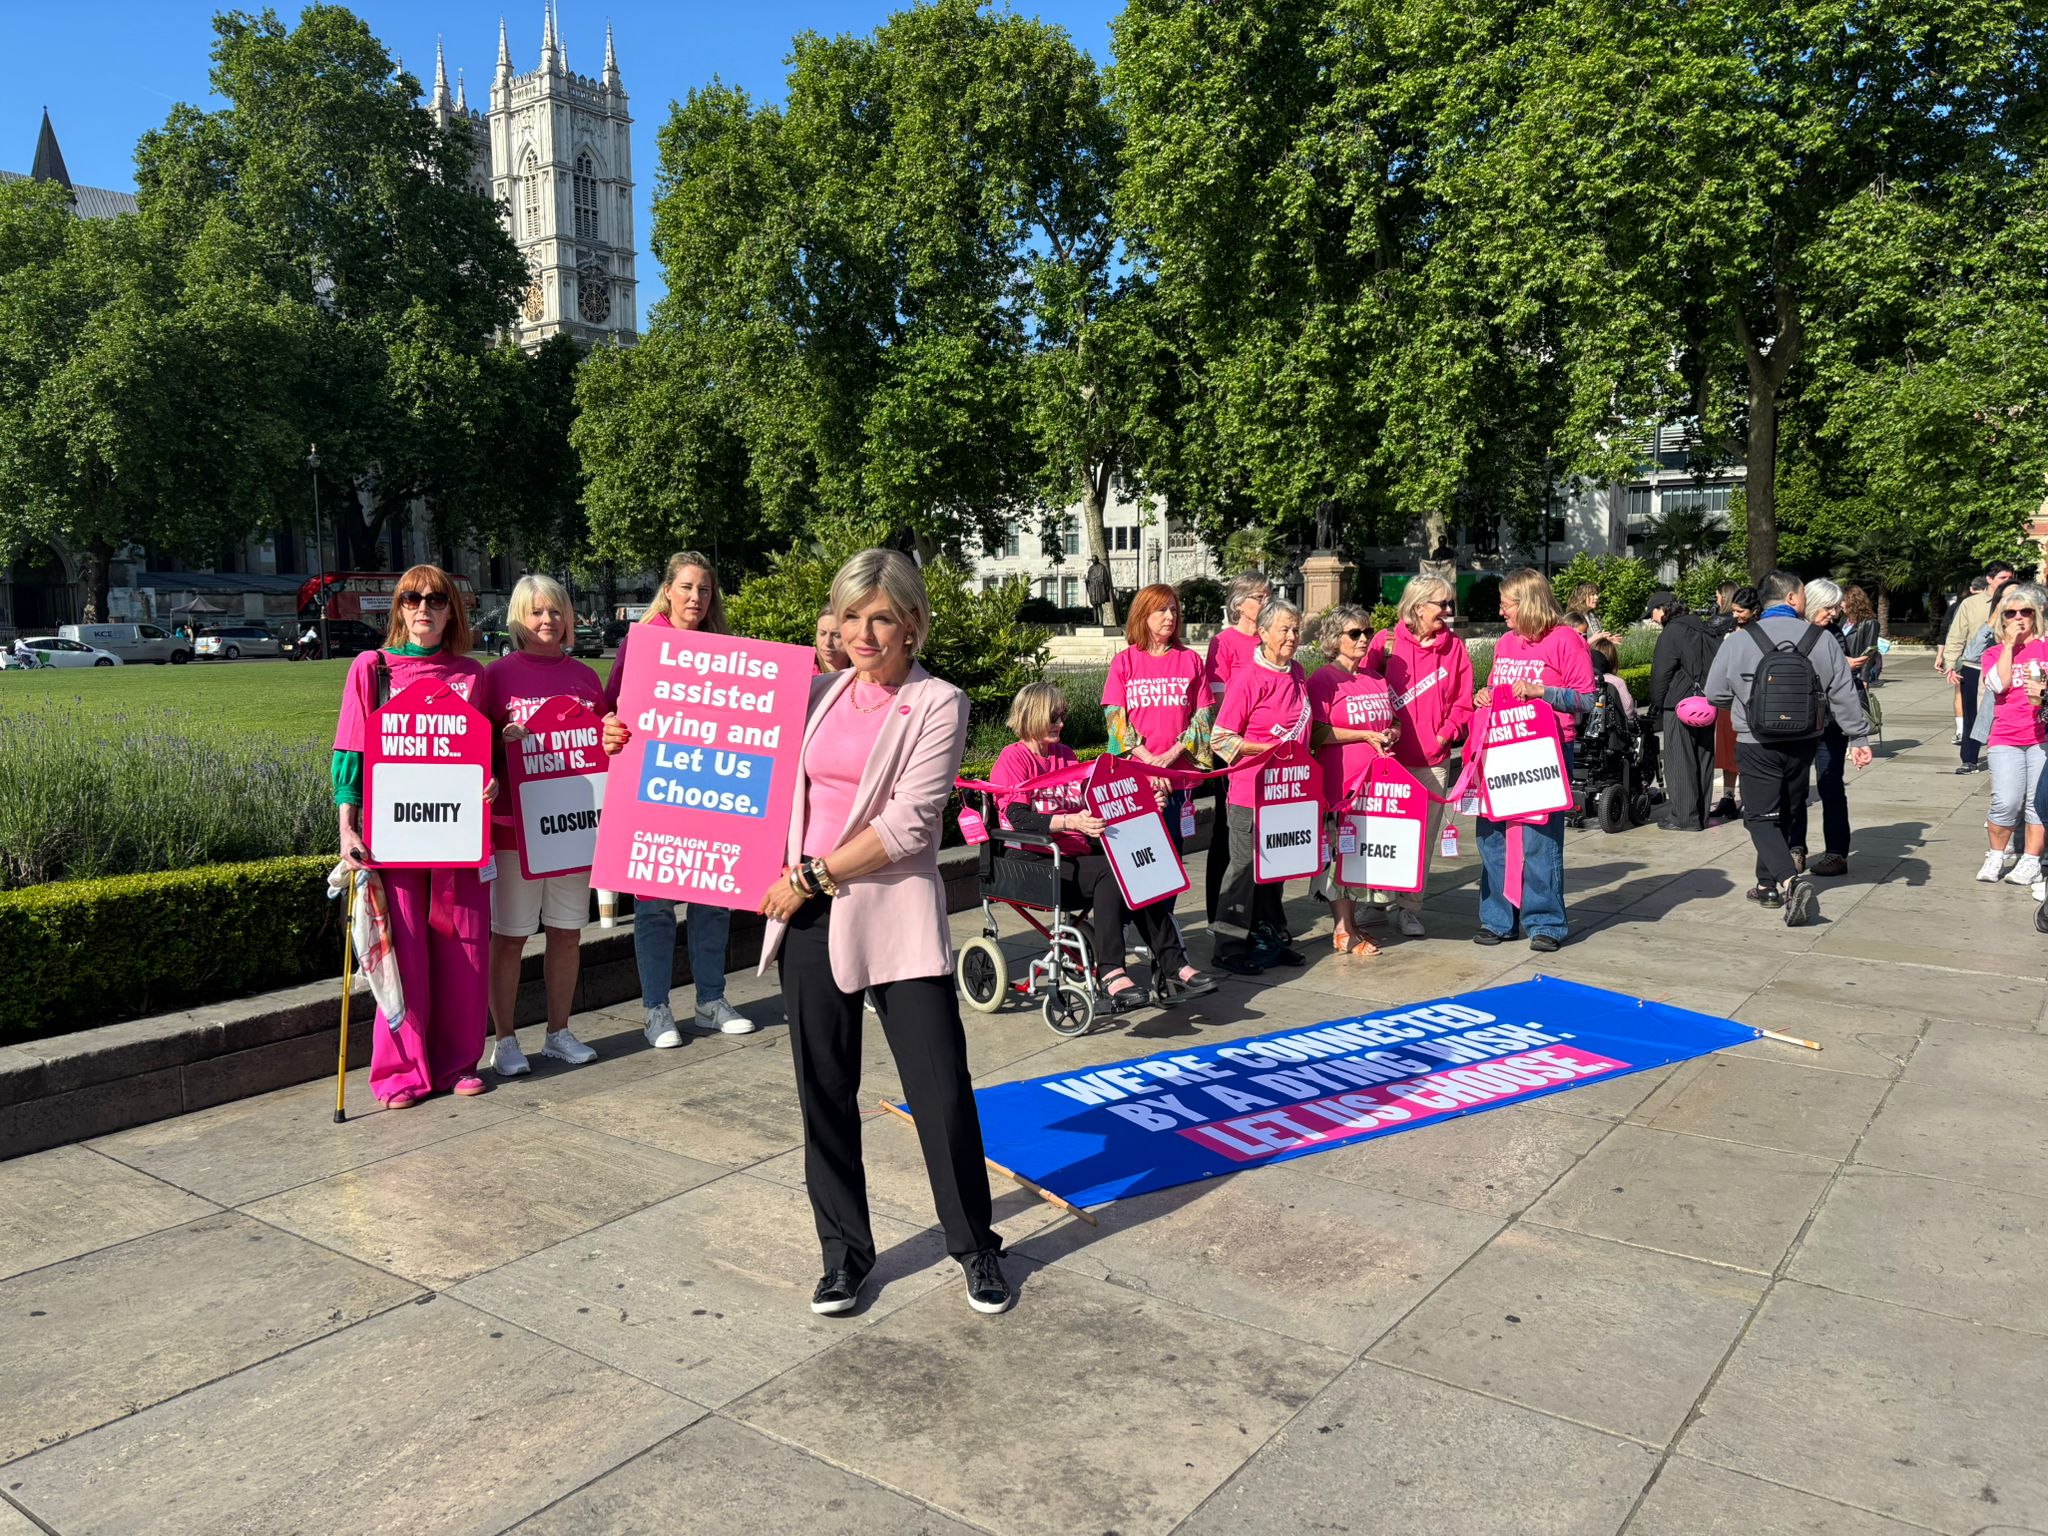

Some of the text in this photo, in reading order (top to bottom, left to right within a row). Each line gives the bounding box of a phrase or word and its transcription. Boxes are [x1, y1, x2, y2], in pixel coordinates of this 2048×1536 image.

[659, 642, 779, 680] Legalise
[1529, 659, 1545, 667] FOR
[1126, 678, 1168, 686] AMPAIGN
[653, 680, 775, 714] assisted
[381, 713, 467, 735] MY DYING
[1348, 712, 1366, 725] IN
[1499, 704, 1536, 725] DYING
[521, 727, 598, 754] MY DYING
[637, 708, 780, 748] dying and
[381, 735, 462, 758] WISH IS...
[523, 749, 597, 775] WISH IS...
[655, 743, 752, 779] Let Us
[1264, 765, 1310, 784] MY DYING
[1487, 764, 1561, 790] COMPASSION
[646, 777, 759, 815] Choose.
[1092, 776, 1139, 804] MY DYING
[1264, 783, 1289, 801] WISH
[1374, 781, 1411, 799] DYING
[393, 802, 462, 823] DIGNITY
[1099, 798, 1125, 821] WISH
[633, 831, 741, 856] CAMPAIGN FOR
[1265, 829, 1312, 849] KINDNESS
[1360, 843, 1397, 859] PEACE
[630, 841, 740, 873] DIGNITY
[1131, 846, 1157, 869] LOVE
[627, 861, 742, 894] IN DYING.
[1041, 1003, 1497, 1106] WE'RE CONNECTED
[1105, 1094, 1210, 1132] BY
[1201, 1083, 1279, 1113] A
[1247, 1051, 1432, 1100] DYING
[1196, 1050, 1614, 1157] LET US CHOOSE.
